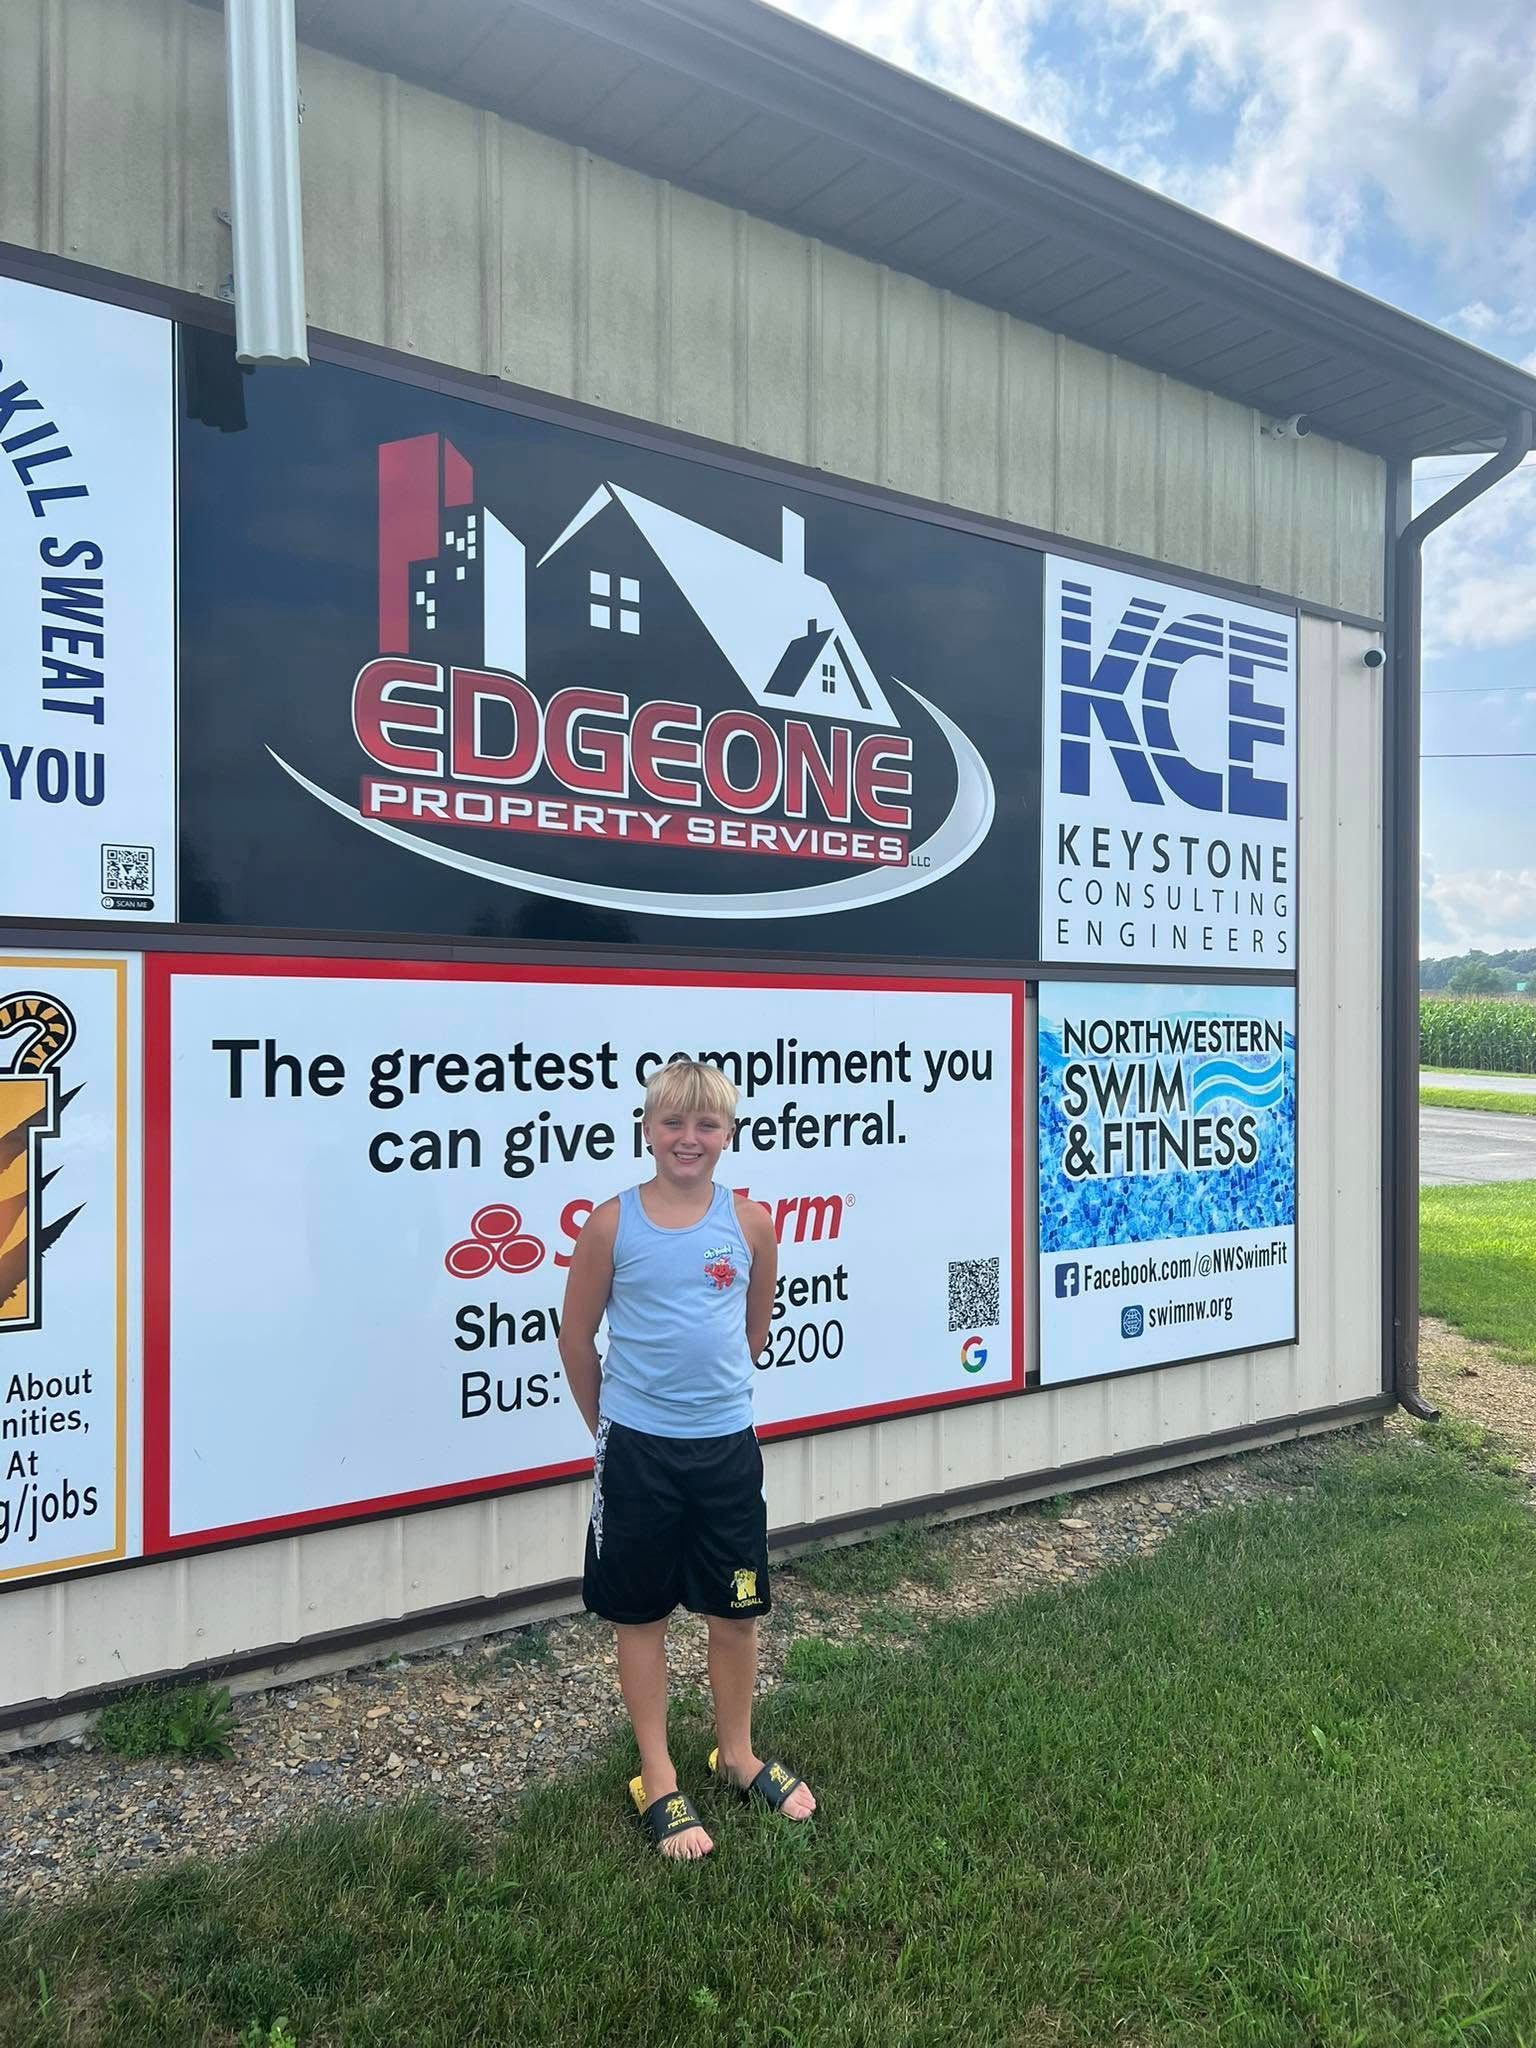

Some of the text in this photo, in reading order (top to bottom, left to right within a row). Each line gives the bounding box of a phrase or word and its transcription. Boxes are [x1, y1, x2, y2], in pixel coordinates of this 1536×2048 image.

[0, 359, 105, 725] KILL SWEAT
[1060, 580, 1289, 821] KCE
[351, 656, 912, 830] EDGEONE
[0, 743, 105, 807] YOU
[370, 784, 931, 868] PROPERTY SERVICES LLC
[1058, 823, 1288, 884] KEYSTONE
[116, 900, 136, 908] SCAN
[1057, 877, 1288, 918] CONSULTING
[1057, 918, 1288, 954] ENGINEERS
[1063, 1017, 1283, 1055] NORTHWESTERN
[211, 1038, 993, 1110] The greatest cmpliment you
[1063, 1058, 1186, 1118] SWIM
[368, 1127, 481, 1173] can
[503, 1110, 616, 1179] give
[732, 1098, 907, 1153] referral.
[771, 1264, 849, 1321] gent
[1084, 1241, 1288, 1292] Facebook.com/@NWSwimFit
[1148, 1296, 1233, 1328] swimnw.org
[6, 1368, 92, 1404] About
[461, 1369, 561, 1419] Bus:
[6, 1450, 39, 1480] At
